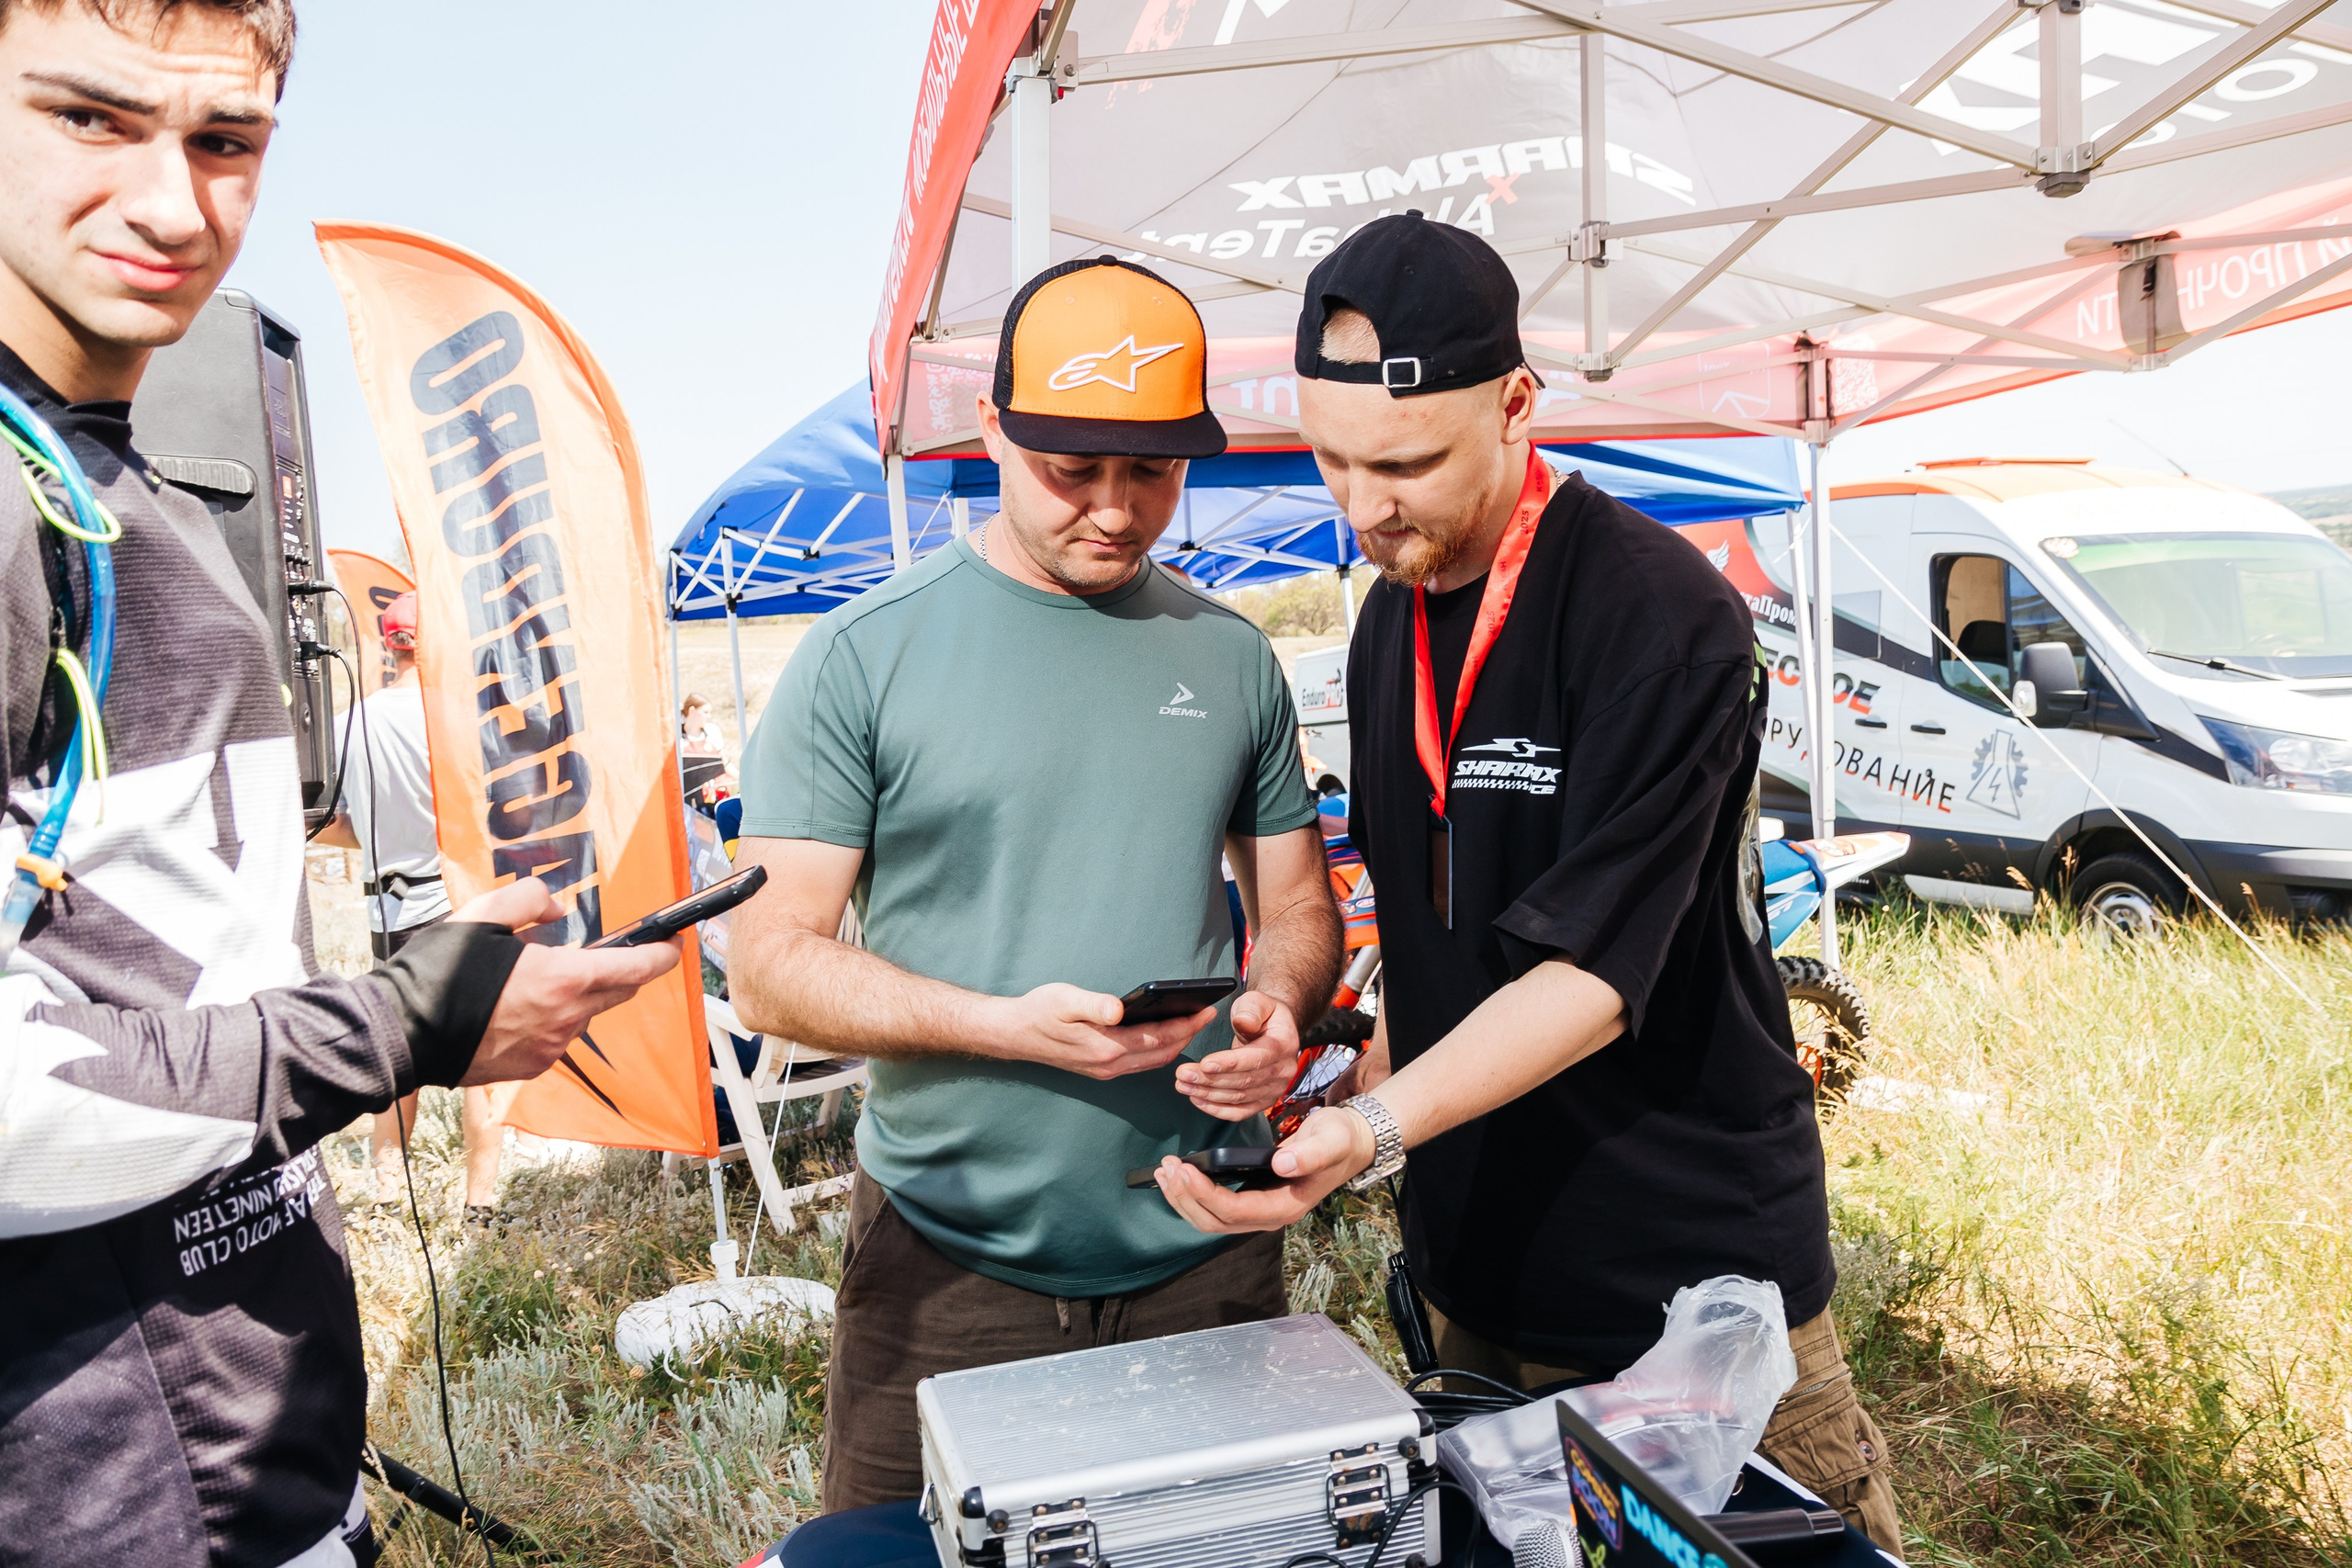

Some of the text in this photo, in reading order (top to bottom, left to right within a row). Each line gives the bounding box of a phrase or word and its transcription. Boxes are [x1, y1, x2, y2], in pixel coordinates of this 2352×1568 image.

[1159, 705, 1208, 719] DEMIX
[1770, 717, 1956, 814] РУОВАНИЕ
[174, 1184, 274, 1244] NINETEEN
[179, 1237, 232, 1277] CLUB
